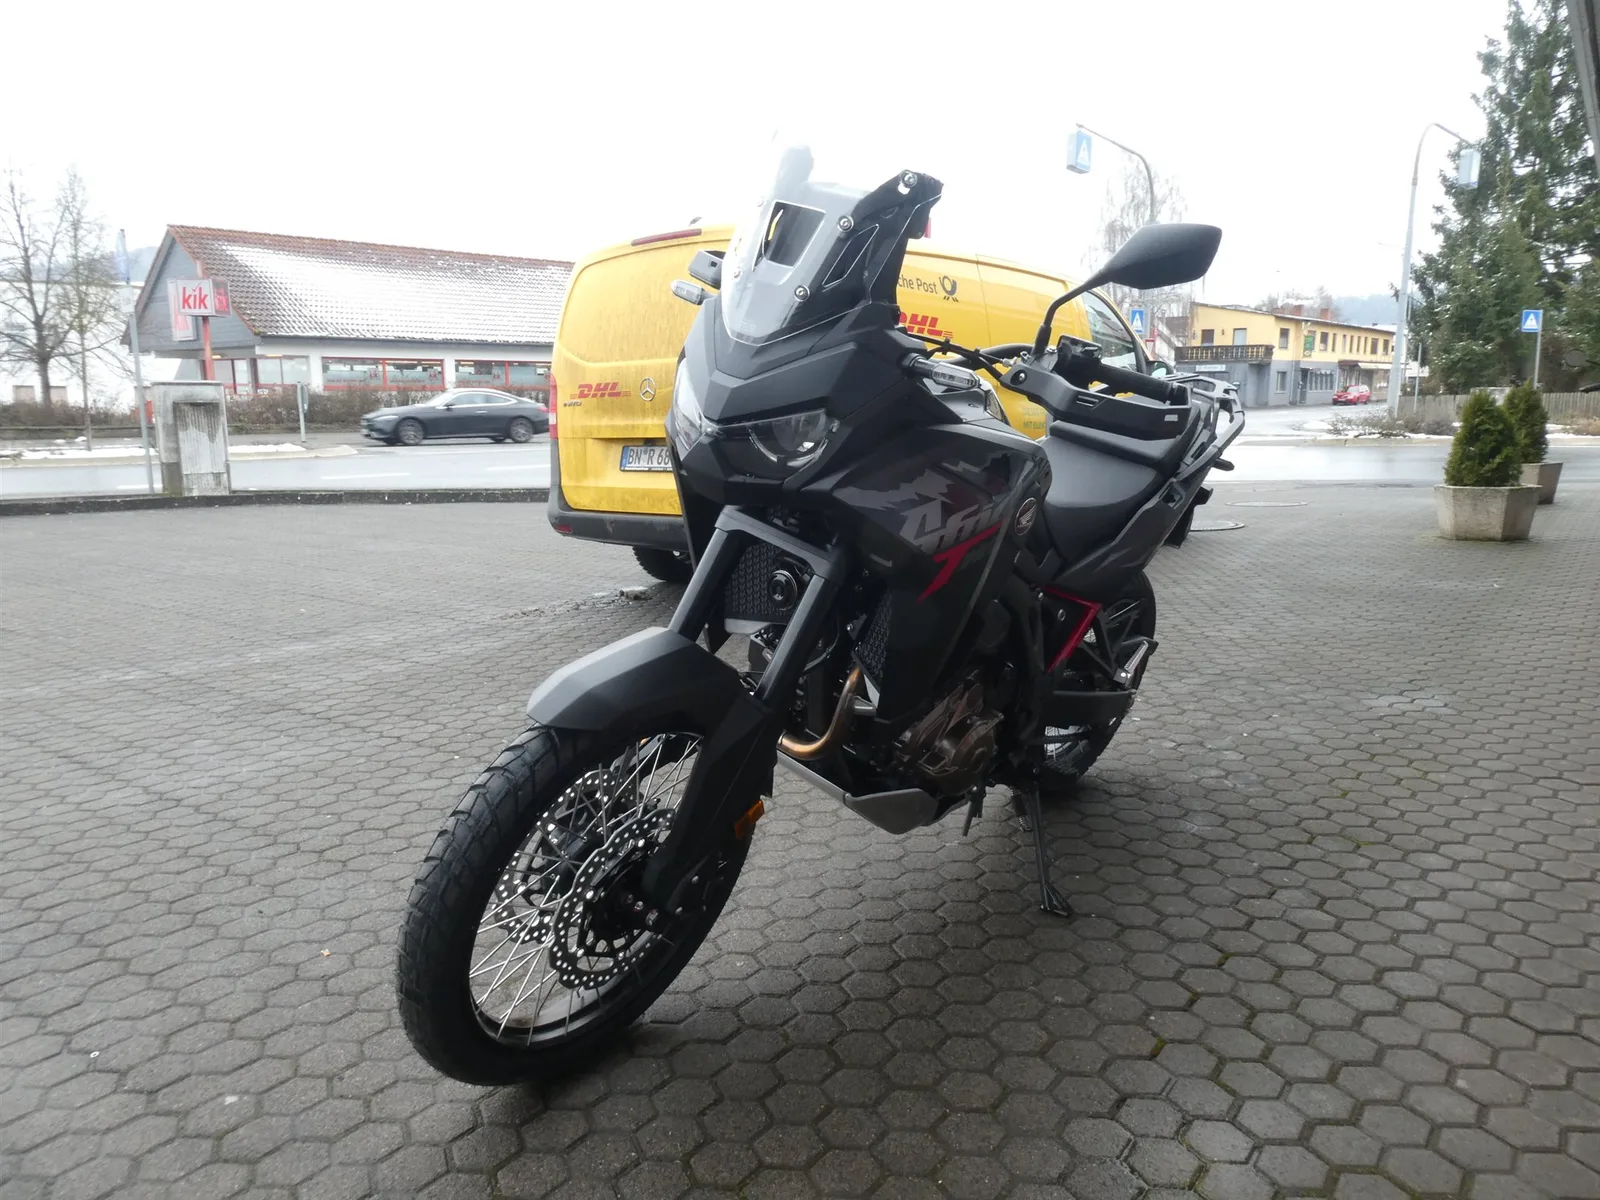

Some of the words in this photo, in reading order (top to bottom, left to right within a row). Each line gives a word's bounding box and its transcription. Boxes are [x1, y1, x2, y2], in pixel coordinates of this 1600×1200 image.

[916, 277, 938, 295] Post
[577, 381, 622, 399] DHL
[627, 448, 642, 466] BN
[647, 448, 656, 466] R
[656, 448, 671, 466] 68
